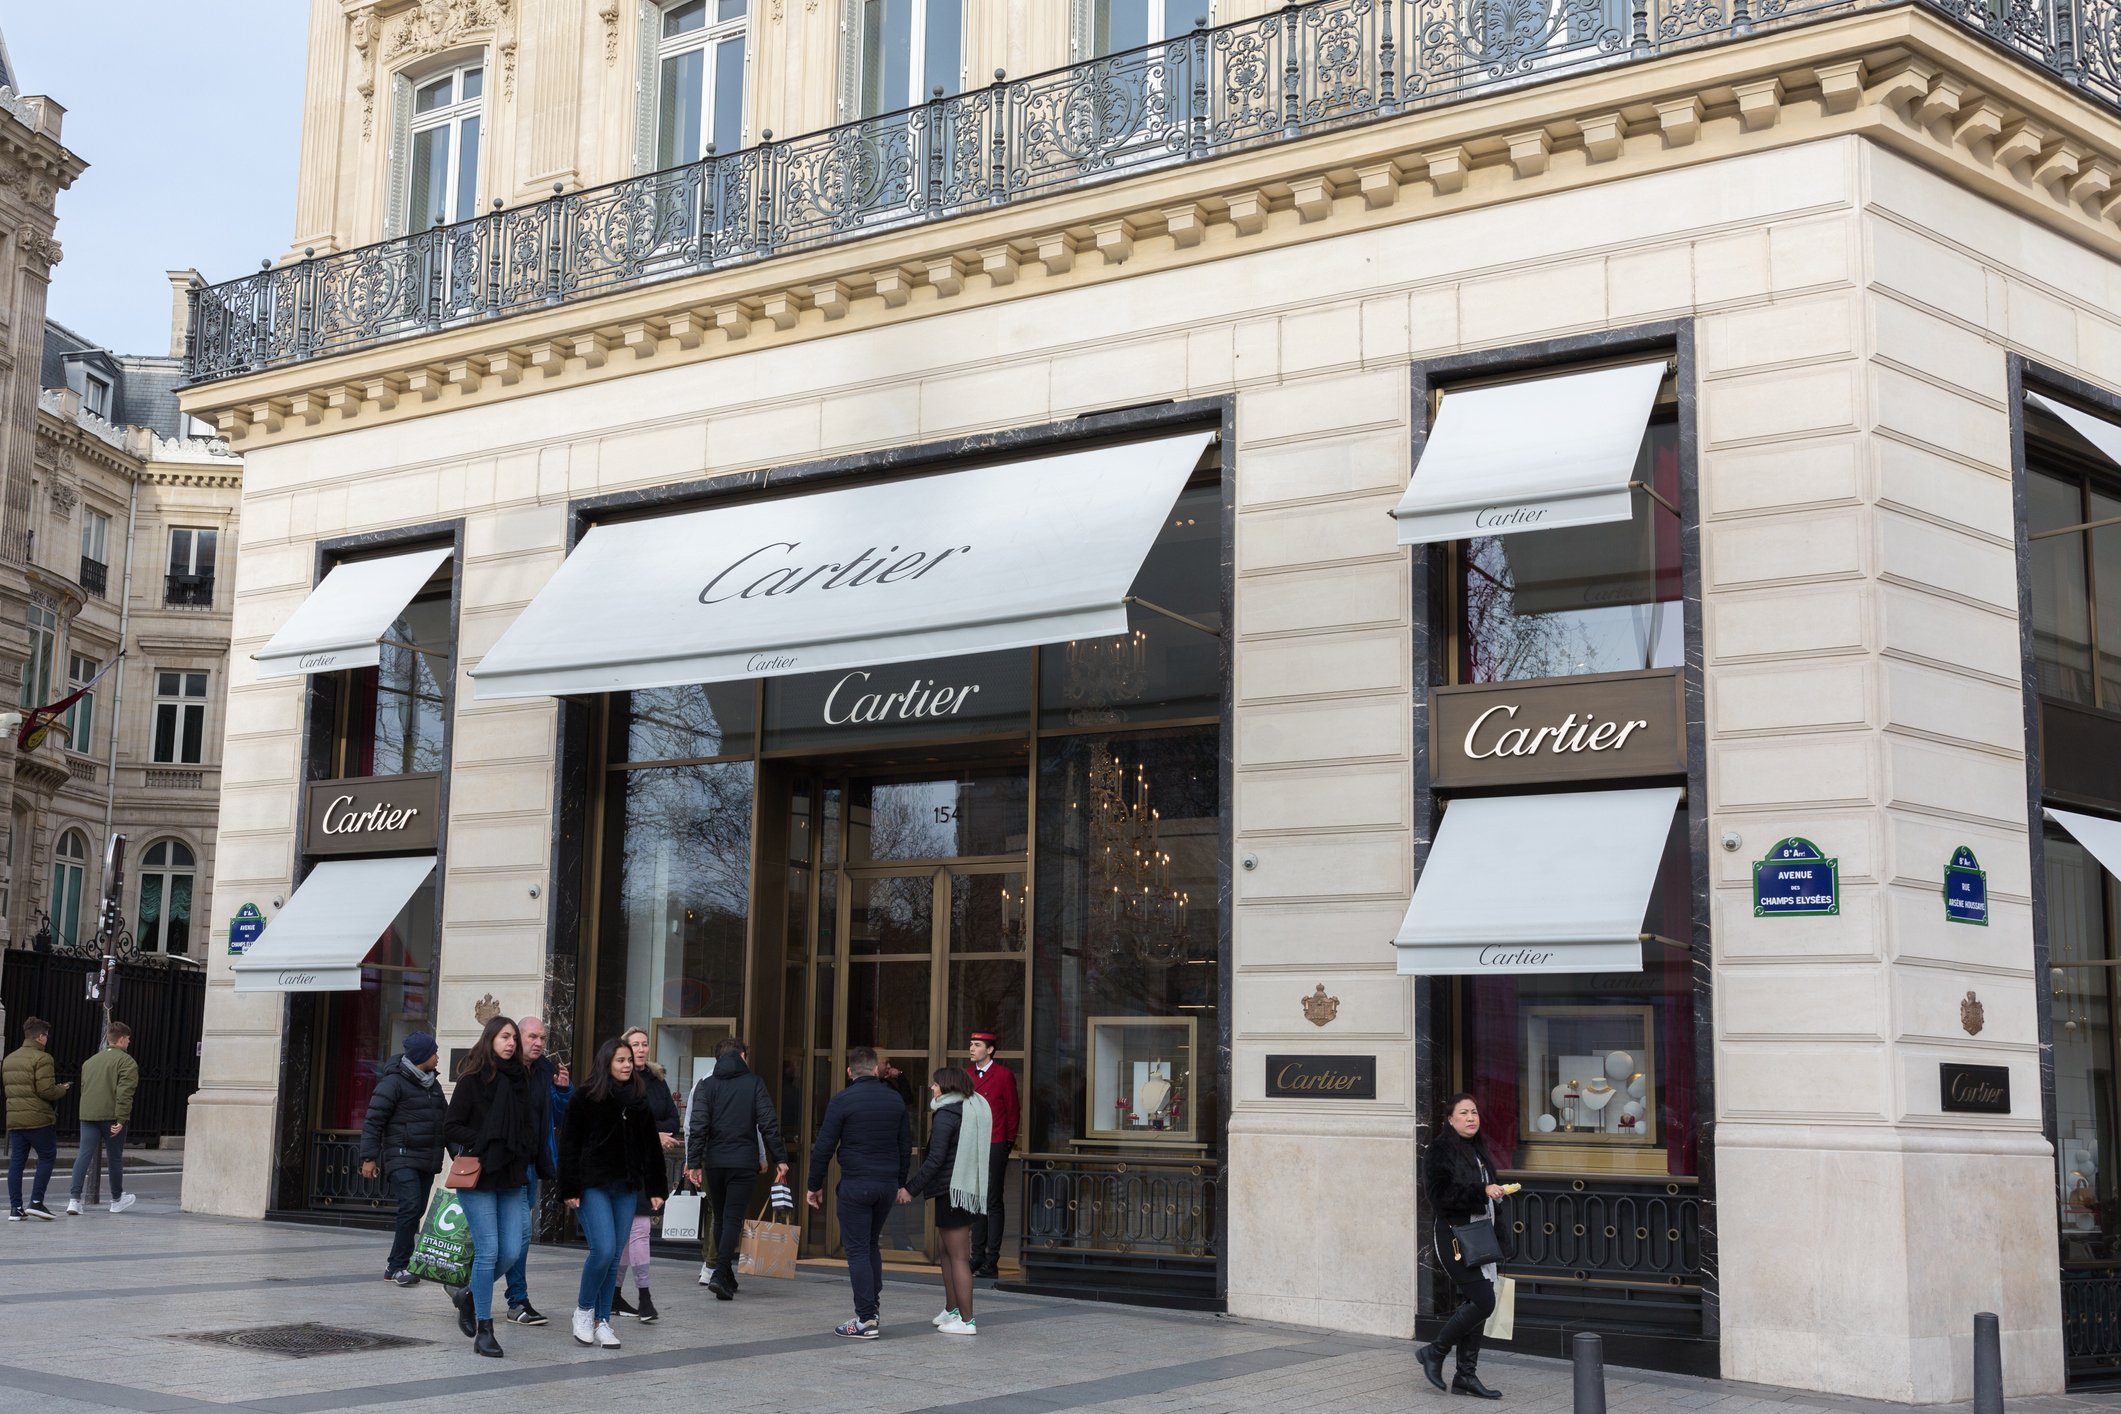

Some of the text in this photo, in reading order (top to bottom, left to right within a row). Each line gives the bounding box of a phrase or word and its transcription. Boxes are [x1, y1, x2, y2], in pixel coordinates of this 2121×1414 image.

[1476, 506, 1548, 528] Cartier
[698, 542, 971, 604] Cartier
[299, 651, 337, 669] Cartier
[746, 653, 798, 672] Cartier
[823, 671, 980, 725] Cartier
[1464, 705, 1647, 759] Cartier
[322, 795, 418, 834] Cartier
[933, 806, 963, 823] 154
[1778, 870, 1813, 880] AVENUE
[1760, 896, 1794, 905] CHAMPS
[1479, 943, 1554, 966] Cartier
[278, 968, 317, 986] Cartier
[1277, 1062, 1362, 1090] Cartier
[1951, 1072, 2005, 1103] Cartier
[438, 1203, 464, 1231] C
[664, 1228, 696, 1237] KENZO
[422, 1236, 462, 1253] CITADIUM
